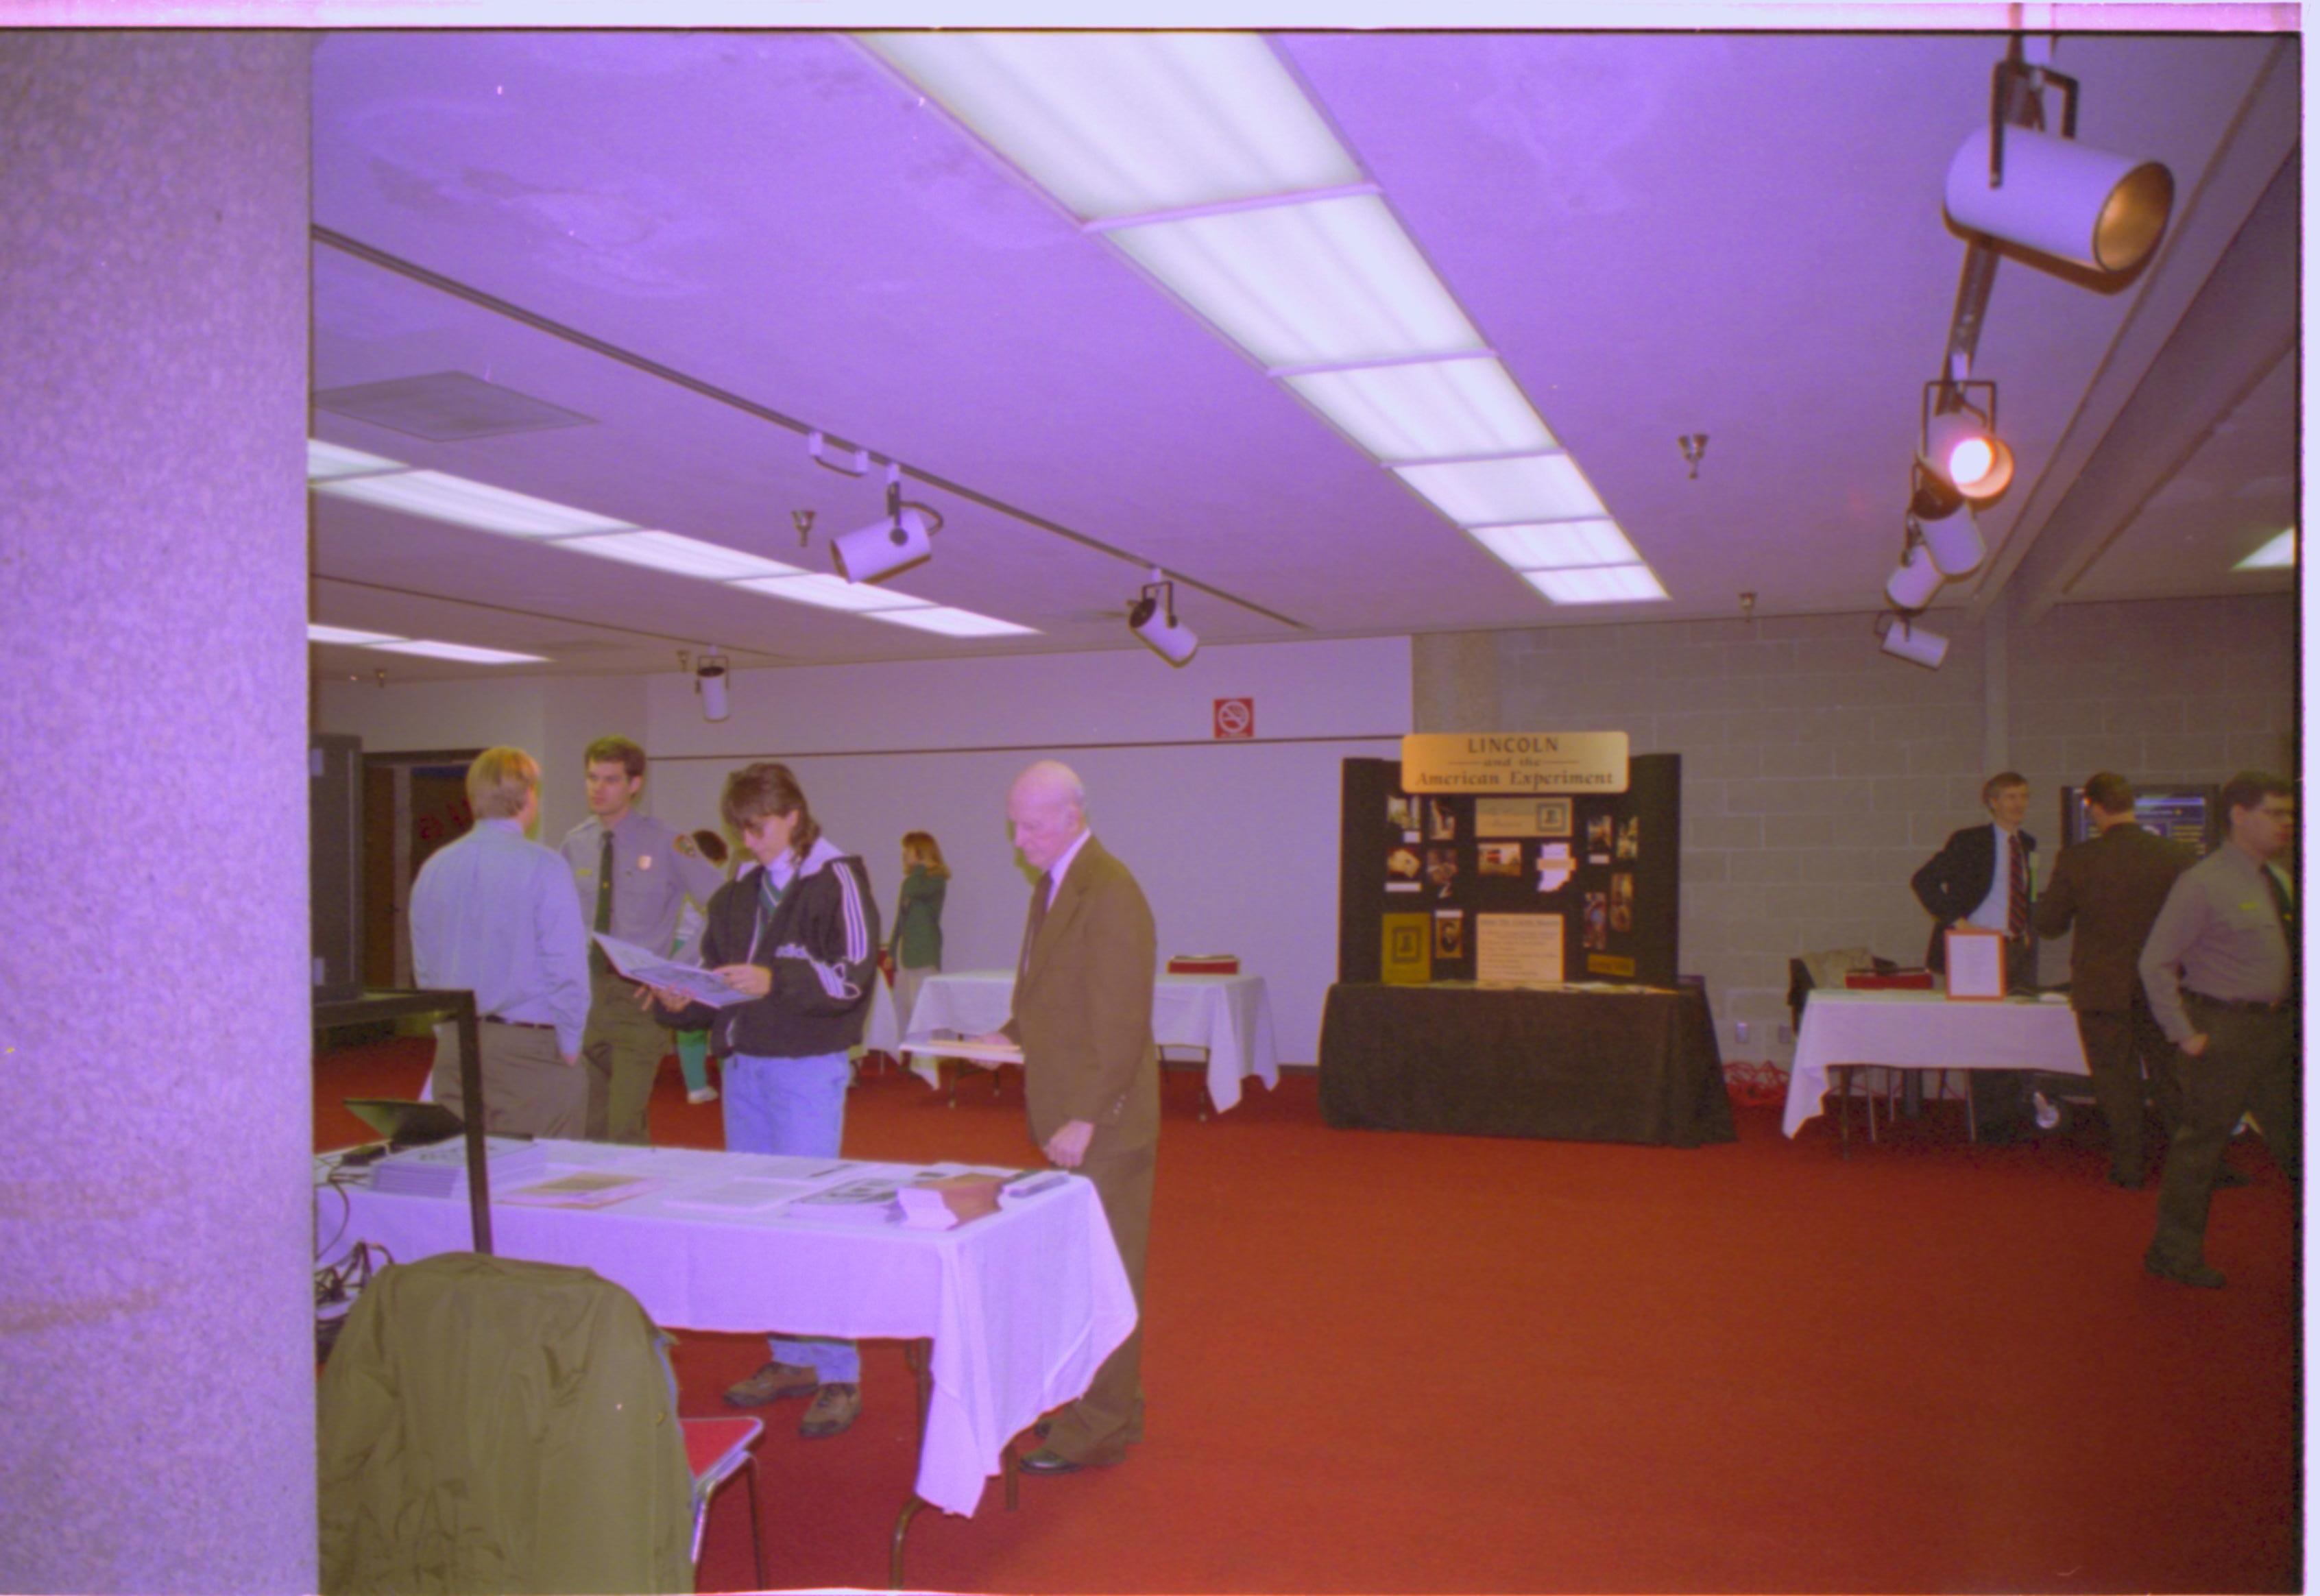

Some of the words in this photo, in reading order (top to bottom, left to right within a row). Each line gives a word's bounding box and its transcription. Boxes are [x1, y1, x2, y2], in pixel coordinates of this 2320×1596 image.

[1468, 738, 1559, 753] LINCOLN
[1484, 757, 1512, 767] and
[1519, 757, 1541, 767] the
[1416, 772, 1499, 786] American
[1511, 771, 1612, 790] Experiment
